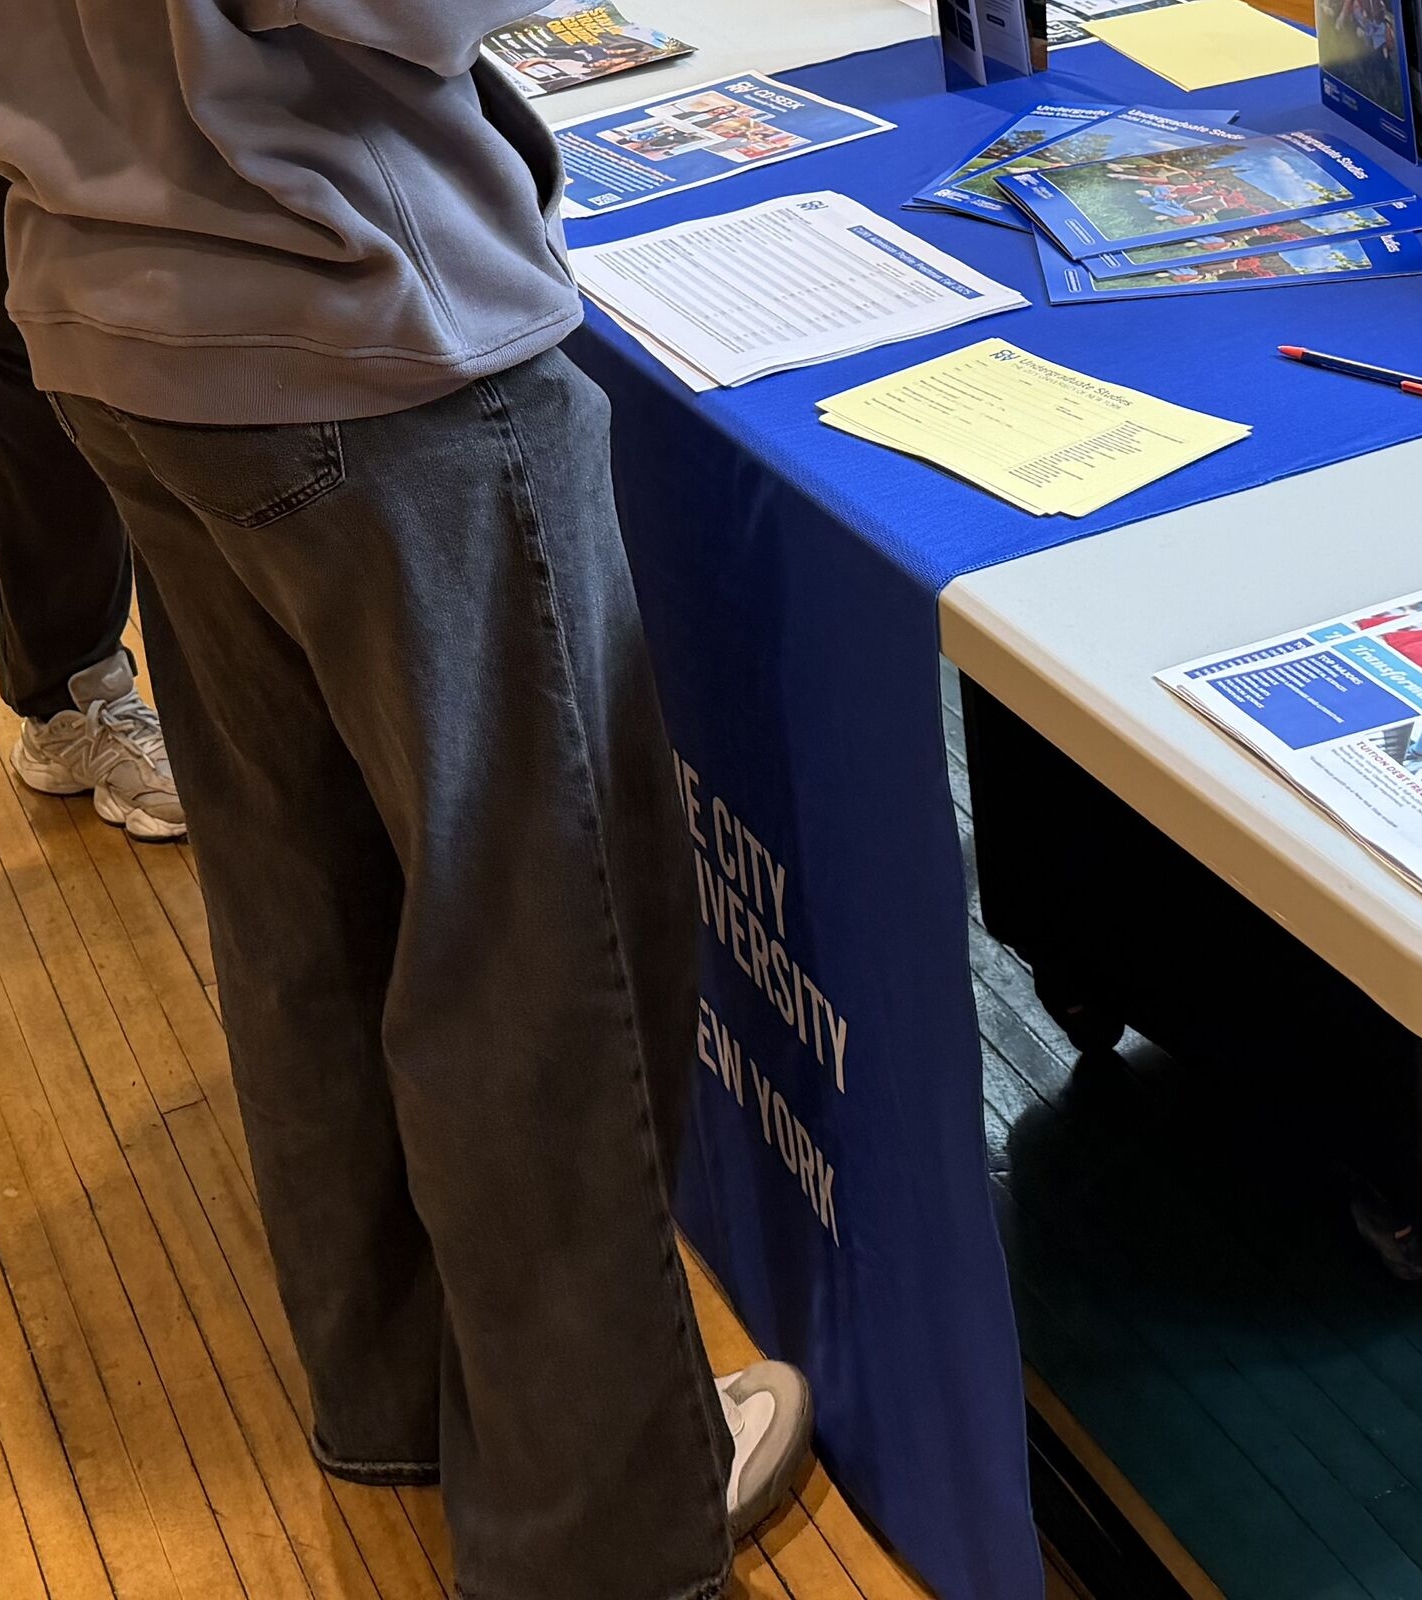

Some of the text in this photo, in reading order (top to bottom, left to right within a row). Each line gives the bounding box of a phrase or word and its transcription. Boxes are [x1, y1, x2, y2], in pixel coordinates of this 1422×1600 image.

[1128, 108, 1208, 134] Undergraduate
[1337, 158, 1368, 179] Studies
[1019, 358, 1134, 406] Undergraduate Studies
[1356, 741, 1389, 767] TUITION
[1386, 764, 1410, 781] DEBT
[713, 797, 785, 940] CITY
[695, 848, 847, 1094] IVERSITY
[697, 997, 840, 1248] EW YORK
